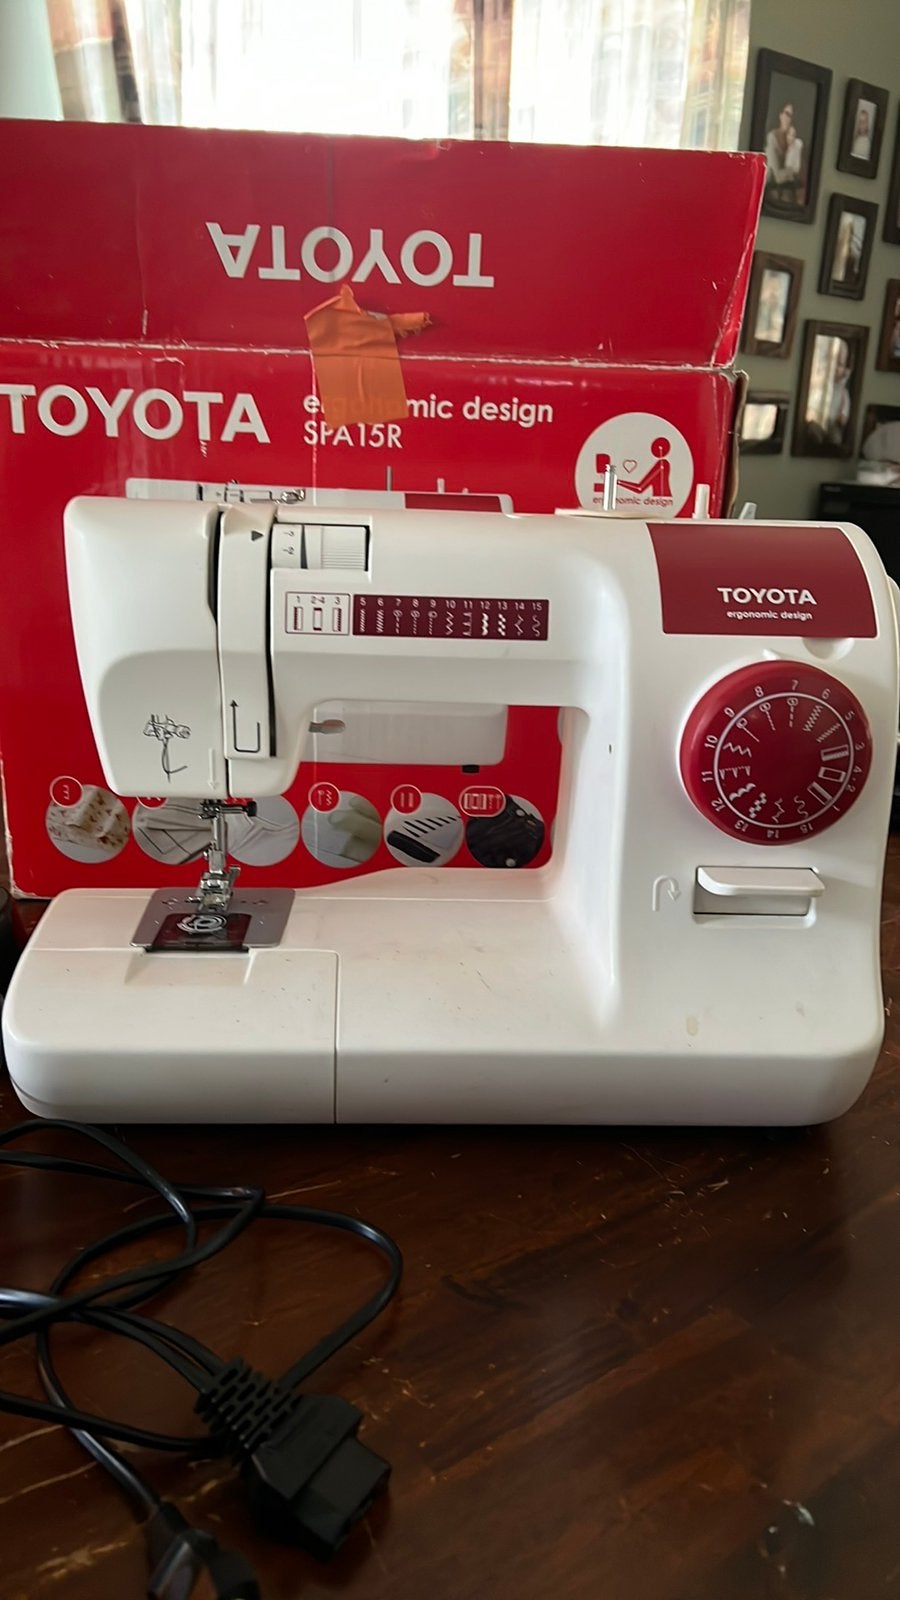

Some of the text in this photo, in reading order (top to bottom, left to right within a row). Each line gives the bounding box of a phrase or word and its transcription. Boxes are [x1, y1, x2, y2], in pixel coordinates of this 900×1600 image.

[205, 222, 494, 287] TOYOTA
[0, 383, 271, 444] TOYOTA
[462, 395, 554, 428] design
[303, 420, 403, 449] SPA15R
[643, 497, 673, 508] design
[716, 587, 818, 605] TOYOTA
[360, 597, 367, 607] 5
[377, 597, 384, 607] 6
[445, 599, 457, 609] 10
[463, 600, 474, 610] 11
[480, 600, 491, 610] 12
[497, 601, 508, 610] 13
[514, 602, 525, 610] 14
[532, 602, 543, 611] 15
[726, 610, 813, 622] ergonomic design
[790, 679, 799, 690] 7
[754, 685, 764, 698] 8
[822, 688, 832, 700] 6
[723, 706, 735, 718] 9
[844, 710, 855, 721] 5
[704, 734, 718, 749] 10
[701, 769, 713, 783] 11
[711, 797, 726, 812] 12
[734, 819, 749, 832] 13
[767, 829, 779, 839] 14
